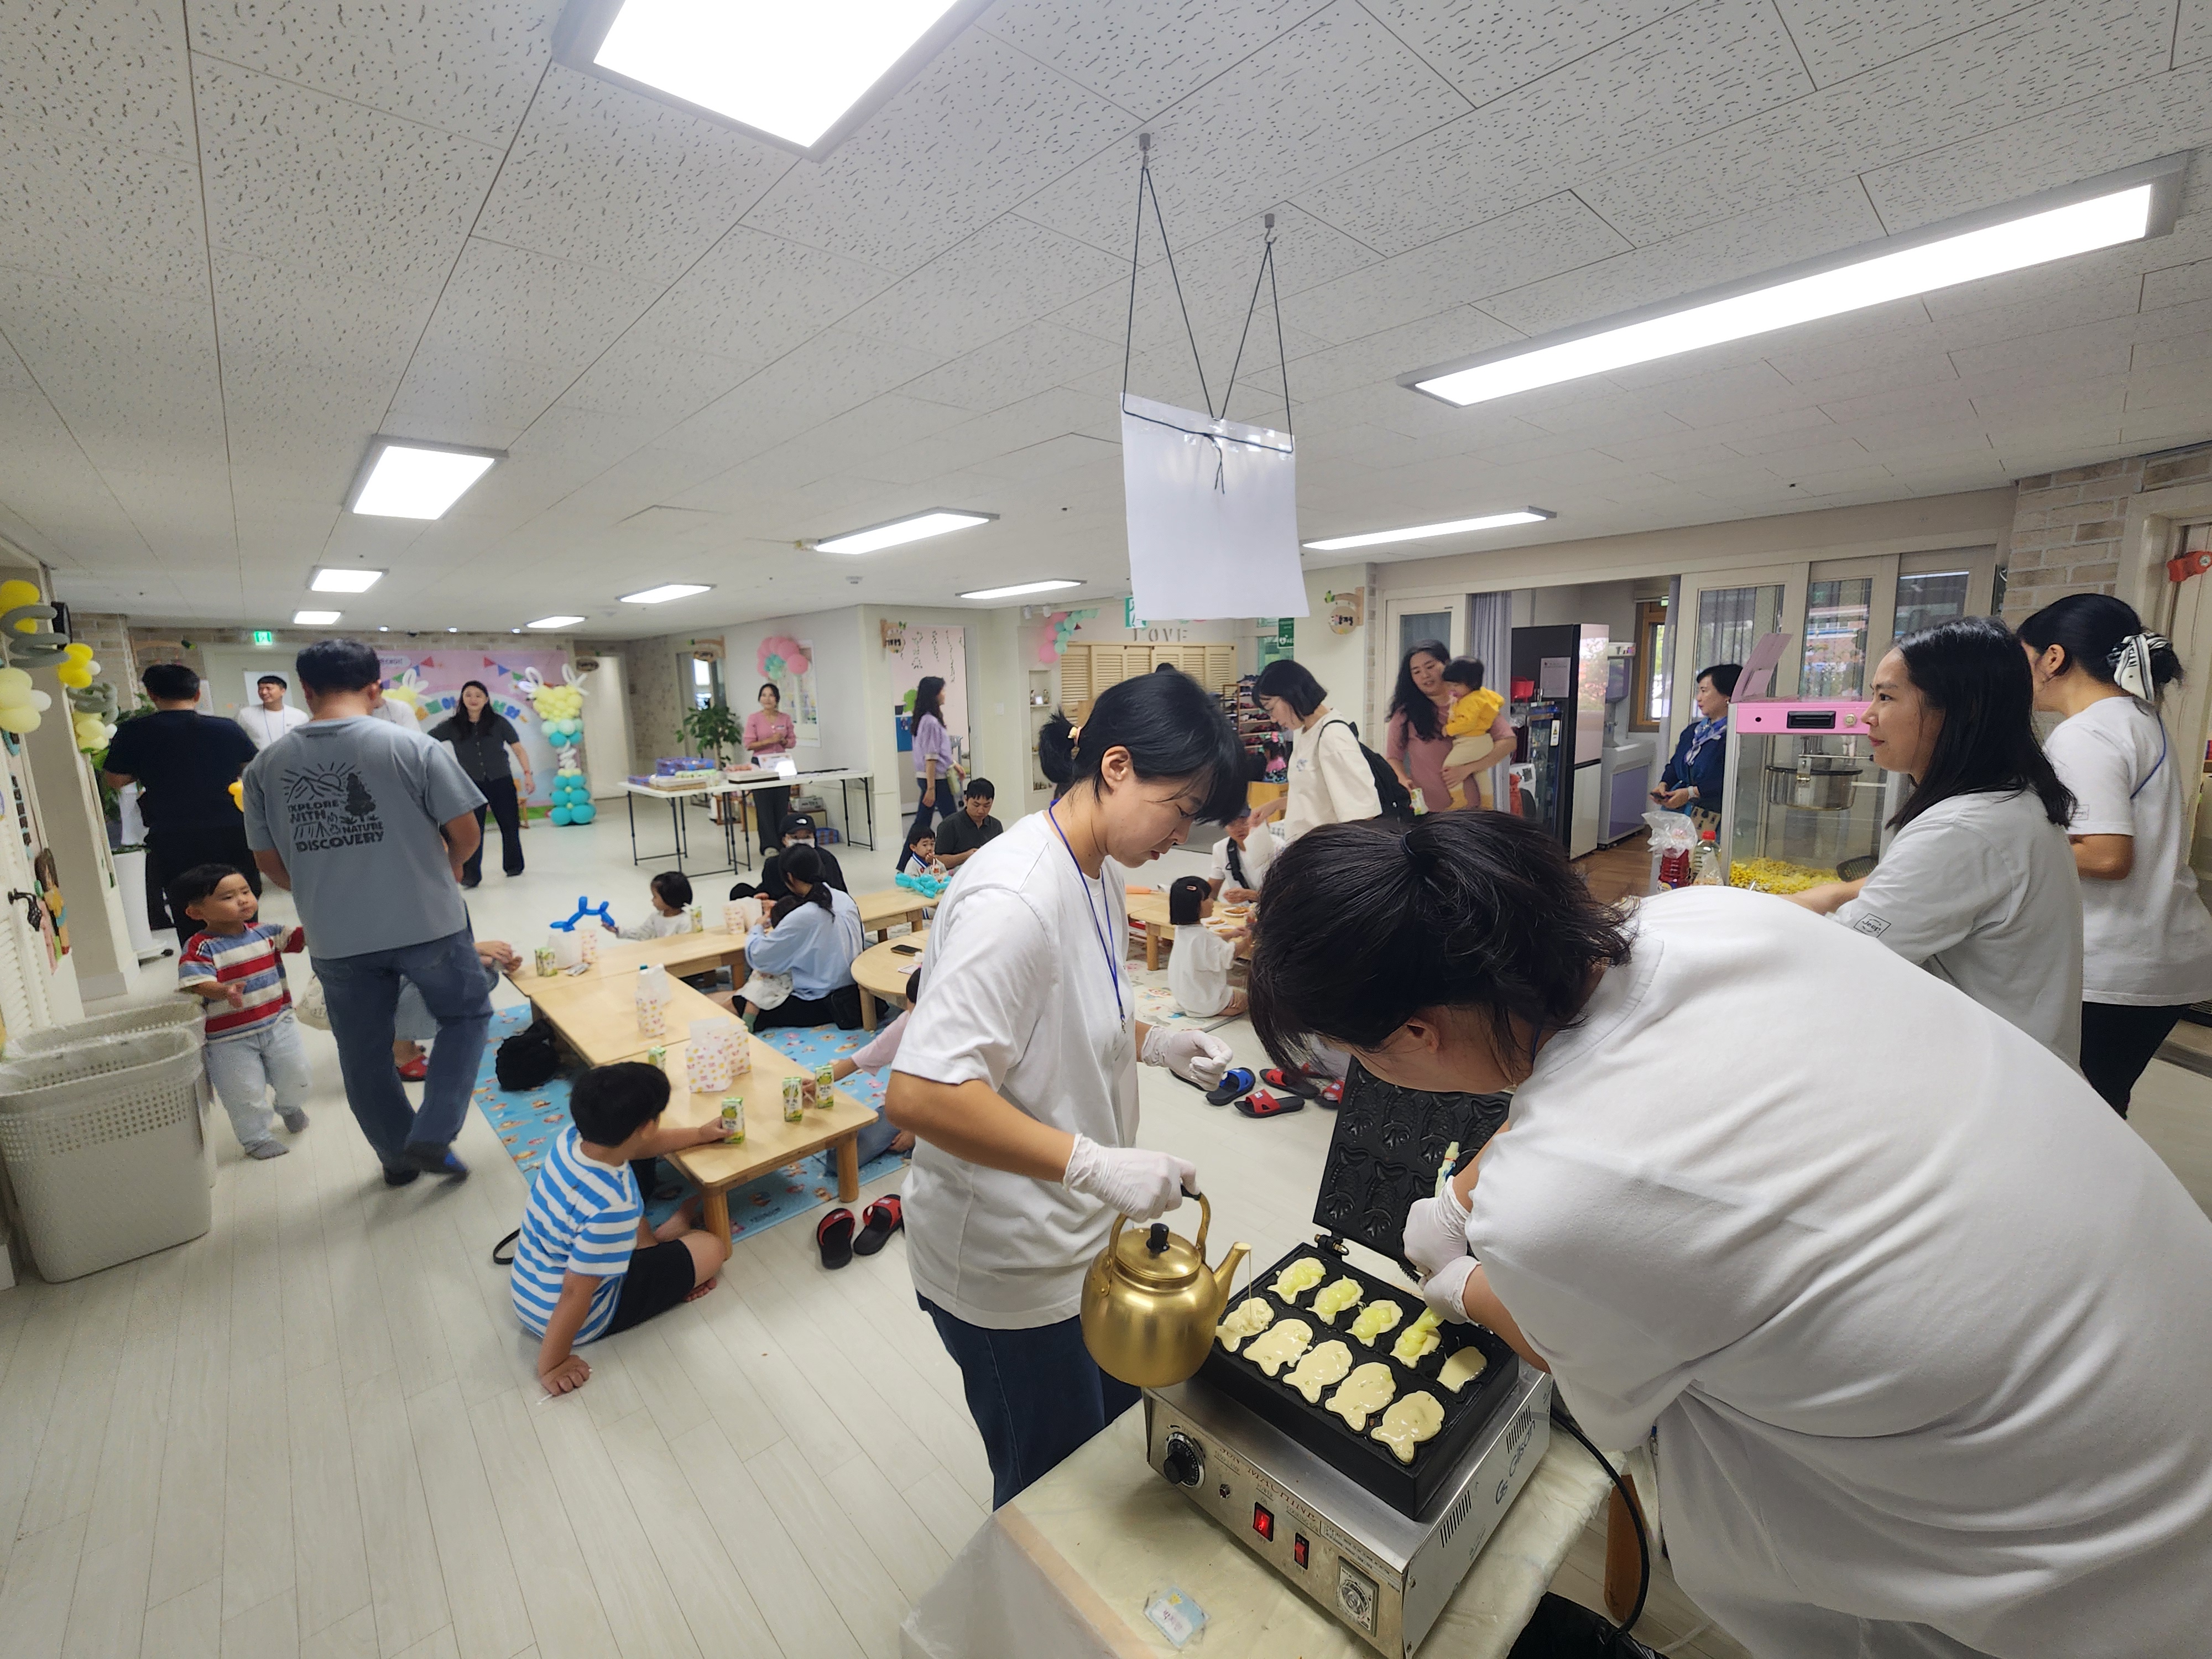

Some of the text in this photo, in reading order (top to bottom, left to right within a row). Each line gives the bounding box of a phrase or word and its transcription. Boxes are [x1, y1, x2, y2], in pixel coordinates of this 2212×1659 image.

[1133, 628, 1188, 641] LOVE
[342, 821, 384, 833] NATURE
[295, 831, 384, 853] DISCOVERY
[1862, 920, 1881, 933] Jeep
[1509, 1420, 1536, 1477] Gilson
